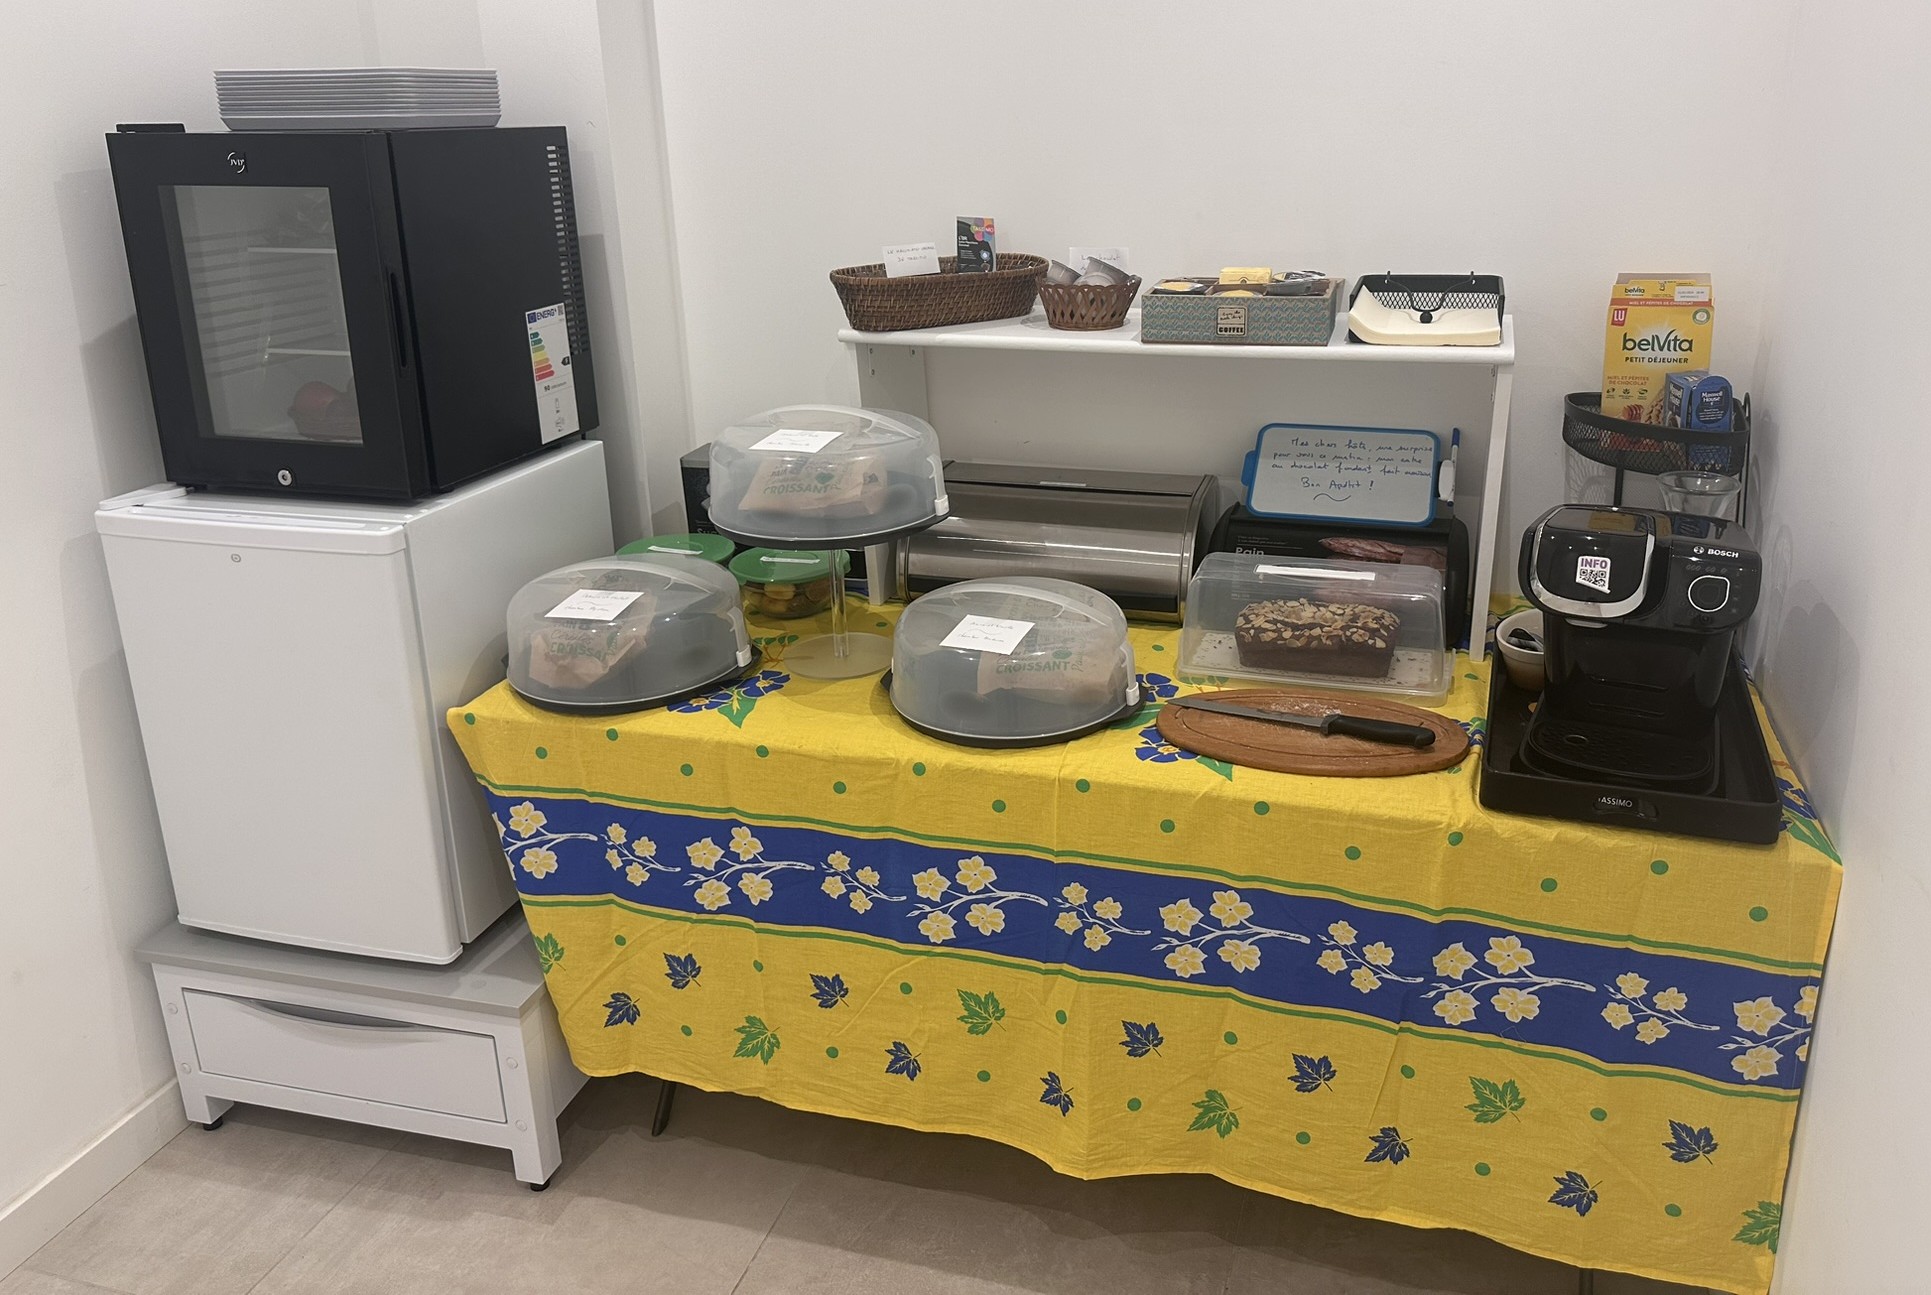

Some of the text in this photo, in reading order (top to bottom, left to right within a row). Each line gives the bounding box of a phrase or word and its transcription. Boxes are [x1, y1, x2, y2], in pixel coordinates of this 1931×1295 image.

[1614, 310, 1625, 321] LU
[1622, 329, 1693, 352] belVita
[1647, 356, 1689, 364] DÉJEUNER
[1273, 452, 1292, 460] pour
[1300, 476, 1321, 488] Bon
[1707, 548, 1739, 558] BOSCH
[1580, 557, 1608, 569] INFO
[995, 660, 1071, 674] CROISSANT
